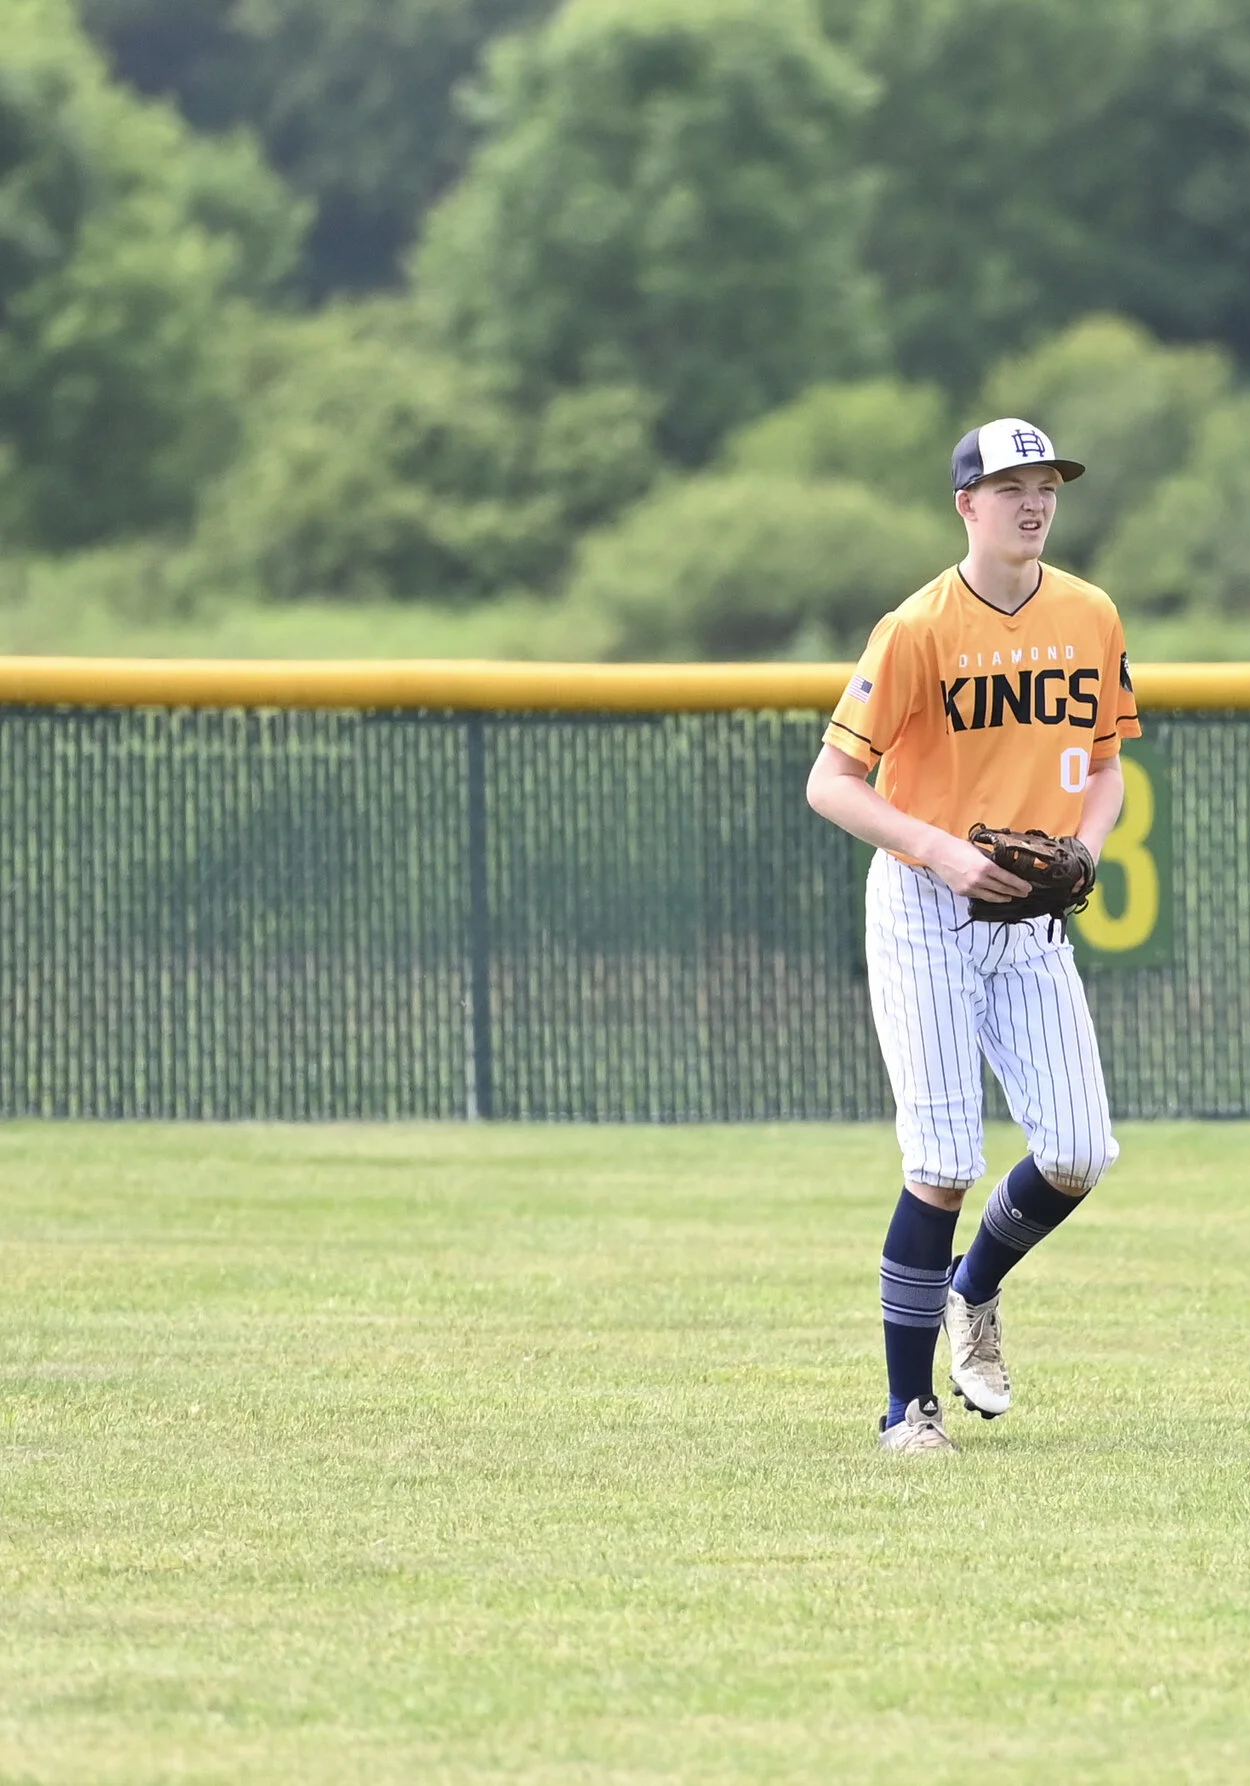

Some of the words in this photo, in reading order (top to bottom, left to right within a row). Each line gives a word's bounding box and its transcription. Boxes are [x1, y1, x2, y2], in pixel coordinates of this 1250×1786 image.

[958, 645, 1075, 668] DIAMOND
[941, 668, 1100, 732] KINGS
[1060, 747, 1089, 793] 0
